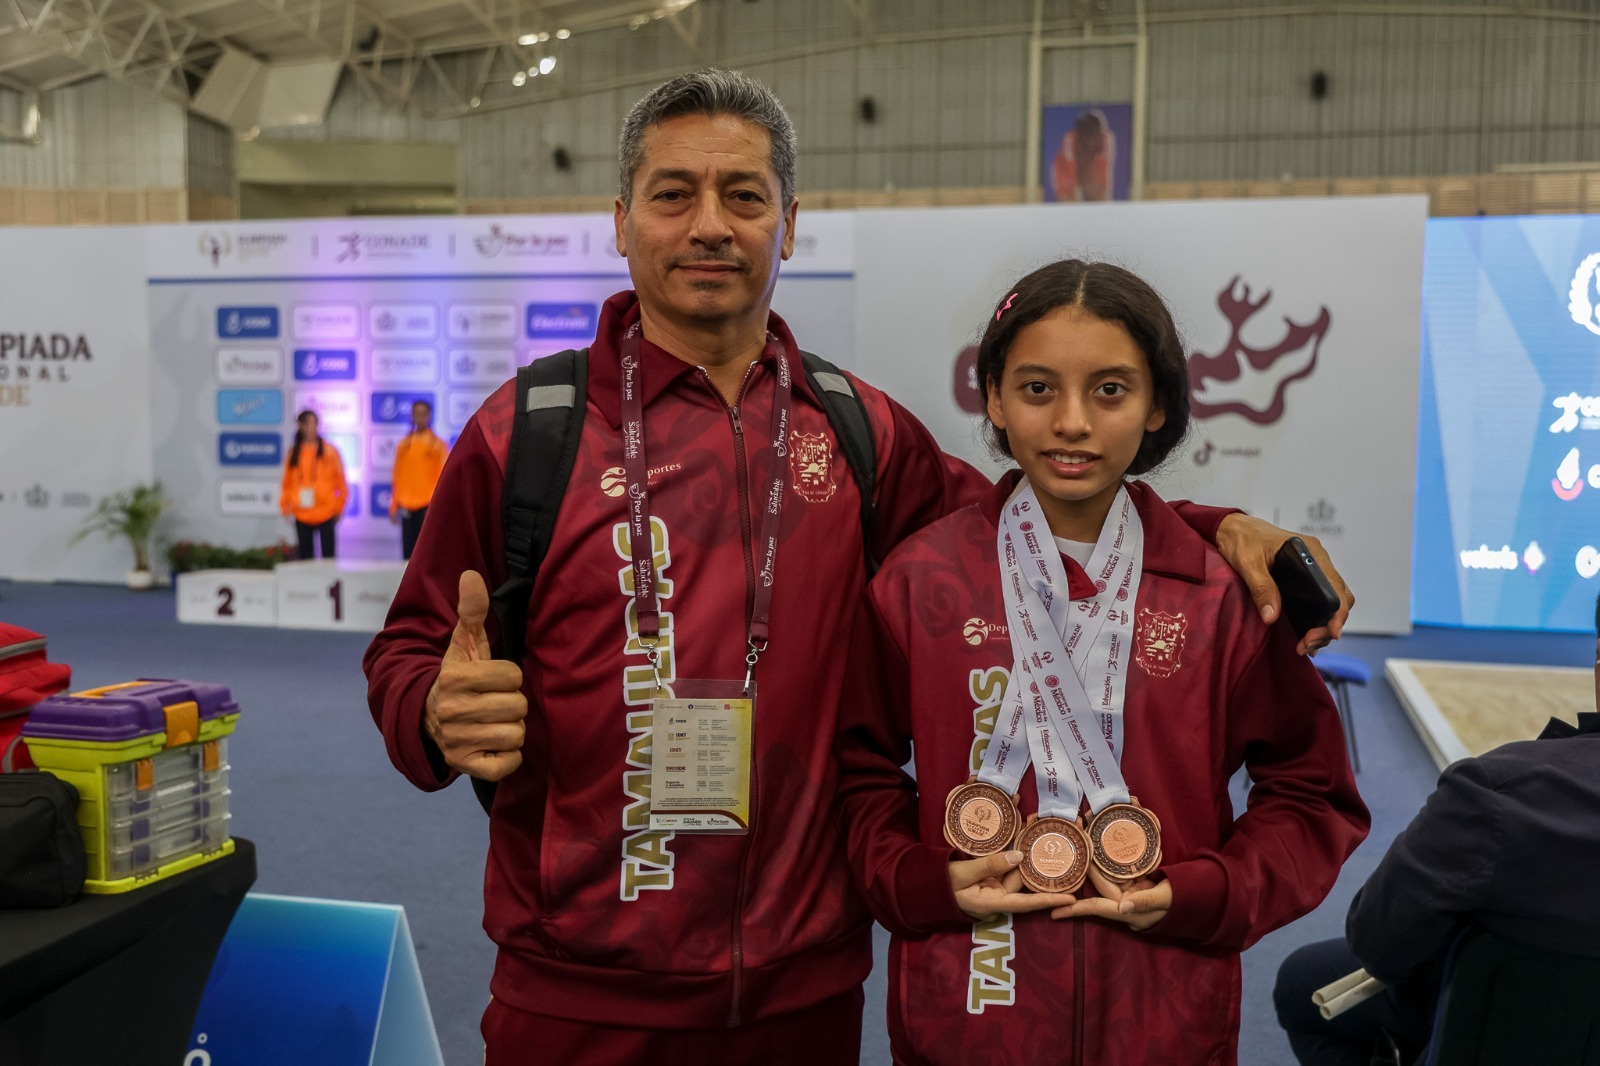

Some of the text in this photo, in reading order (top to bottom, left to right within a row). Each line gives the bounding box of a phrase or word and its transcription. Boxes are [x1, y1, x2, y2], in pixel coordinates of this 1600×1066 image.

[0, 333, 92, 361] PIADA
[628, 421, 638, 459] Saludable
[647, 463, 682, 479] portes
[1023, 532, 1037, 555] México
[1113, 523, 1124, 549] Educación
[764, 558, 772, 571] Por
[1005, 542, 1013, 568] México
[1103, 555, 1120, 581] México
[639, 559, 650, 598] Saludable
[1038, 559, 1053, 585] Educación
[1123, 561, 1134, 589] México
[216, 585, 236, 617] 2
[328, 579, 343, 621] 1
[1013, 572, 1024, 604] Educación
[1025, 618, 1039, 642] CONADE
[1067, 623, 1082, 648] CONADE
[1109, 633, 1118, 659] CONADE
[1050, 688, 1066, 716] México
[1057, 687, 1069, 708] Gobierno
[1101, 675, 1112, 706] Educación
[1009, 705, 1023, 737] Educación
[1033, 695, 1043, 723] México
[1069, 719, 1087, 750] Educación
[1105, 713, 1113, 740] México
[1042, 729, 1053, 761] Educación
[1090, 765, 1105, 790] CONADE
